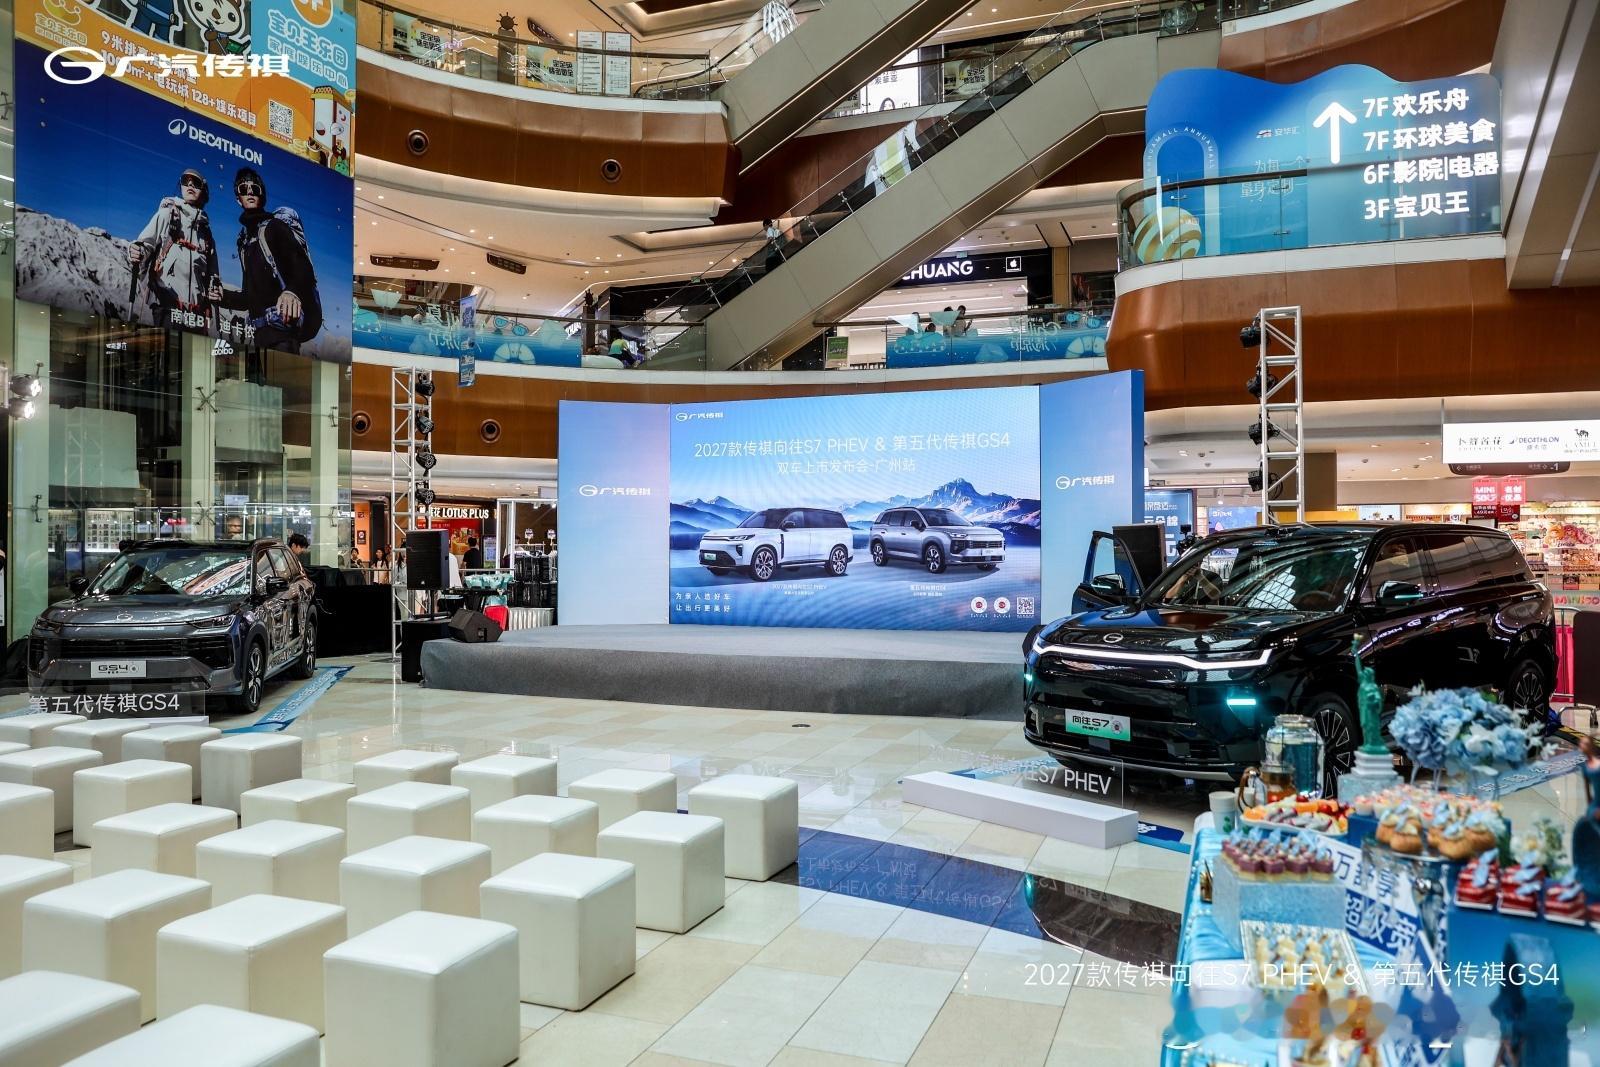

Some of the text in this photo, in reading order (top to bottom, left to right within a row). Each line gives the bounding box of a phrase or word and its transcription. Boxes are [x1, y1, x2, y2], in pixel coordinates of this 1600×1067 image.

[267, 9, 349, 71] 宝贝王乐园
[1362, 87, 1470, 119] 7F 欢乐舟
[188, 125, 263, 166] DECATHLON
[1362, 117, 1497, 152] 7F 环球美食
[1363, 163, 1390, 185] 6F
[1364, 189, 1470, 220] 3F 宝贝王
[170, 308, 257, 340] 南馆B1 迪卡侬
[694, 431, 1011, 458] 2027款传祺向往S7 PHEV & 第五代传祺GS4
[1518, 436, 1560, 444] DECATHLON
[599, 487, 651, 496] 广汽传祺
[1071, 474, 1115, 488] 广汽传祺
[442, 507, 468, 519] LOTUS
[469, 508, 490, 520] PLUS
[675, 603, 731, 613] 让出行更美好
[98, 664, 129, 672] GS4
[30, 693, 181, 714] 第五代传祺GS4
[1072, 715, 1110, 728] 向往S7
[1064, 769, 1112, 795] PHEV
